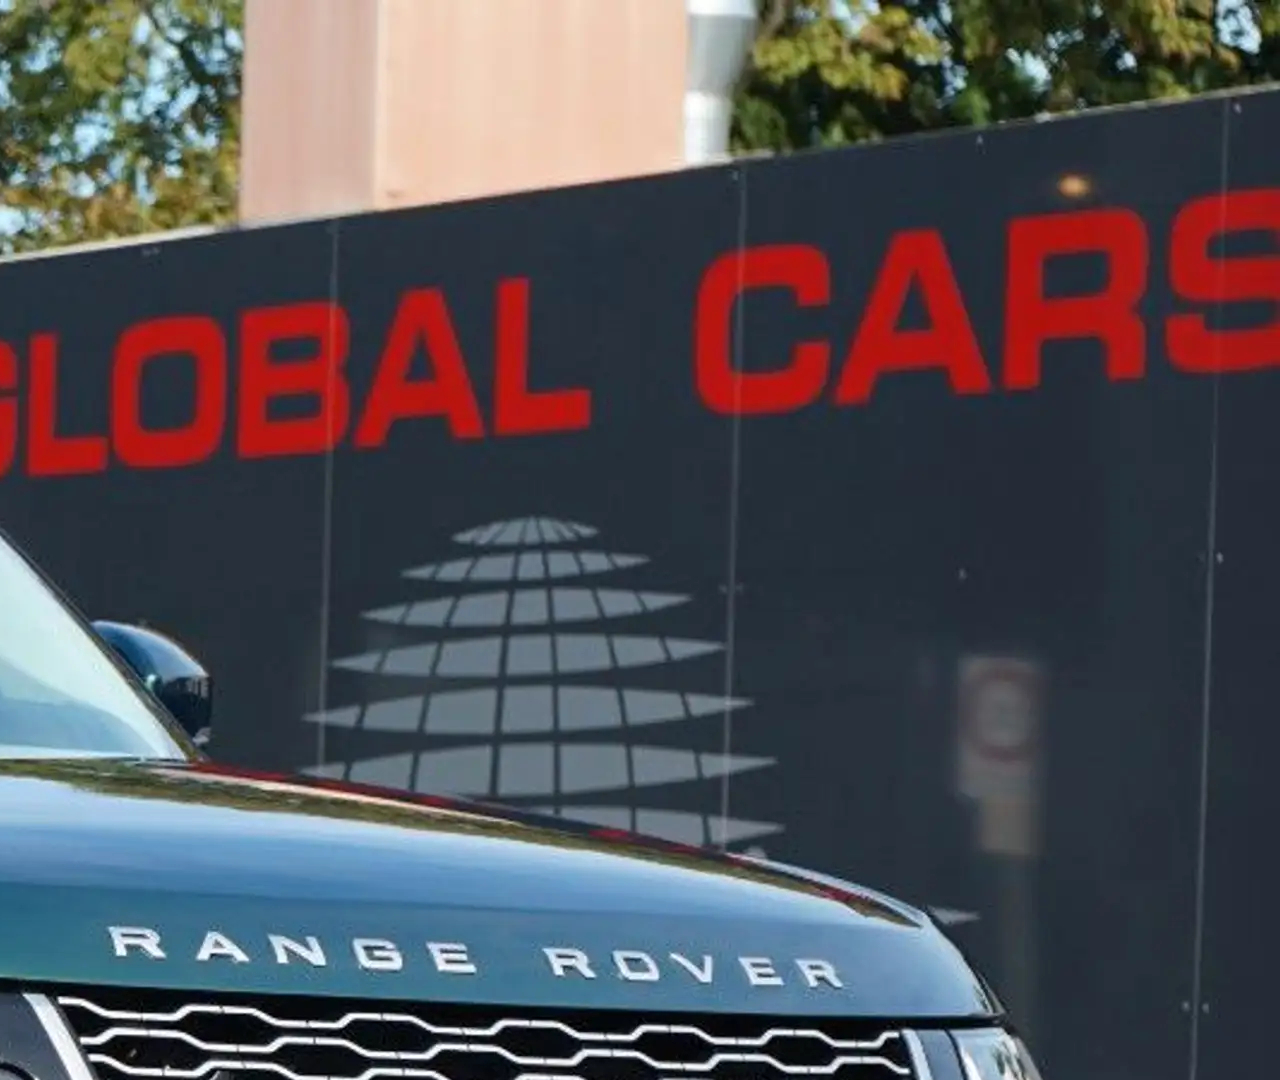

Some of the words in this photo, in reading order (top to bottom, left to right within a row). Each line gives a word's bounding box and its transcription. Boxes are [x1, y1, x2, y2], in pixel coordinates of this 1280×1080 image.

[693, 188, 1280, 416] CARS
[108, 926, 477, 974] RANGE
[543, 947, 843, 988] ROVER
